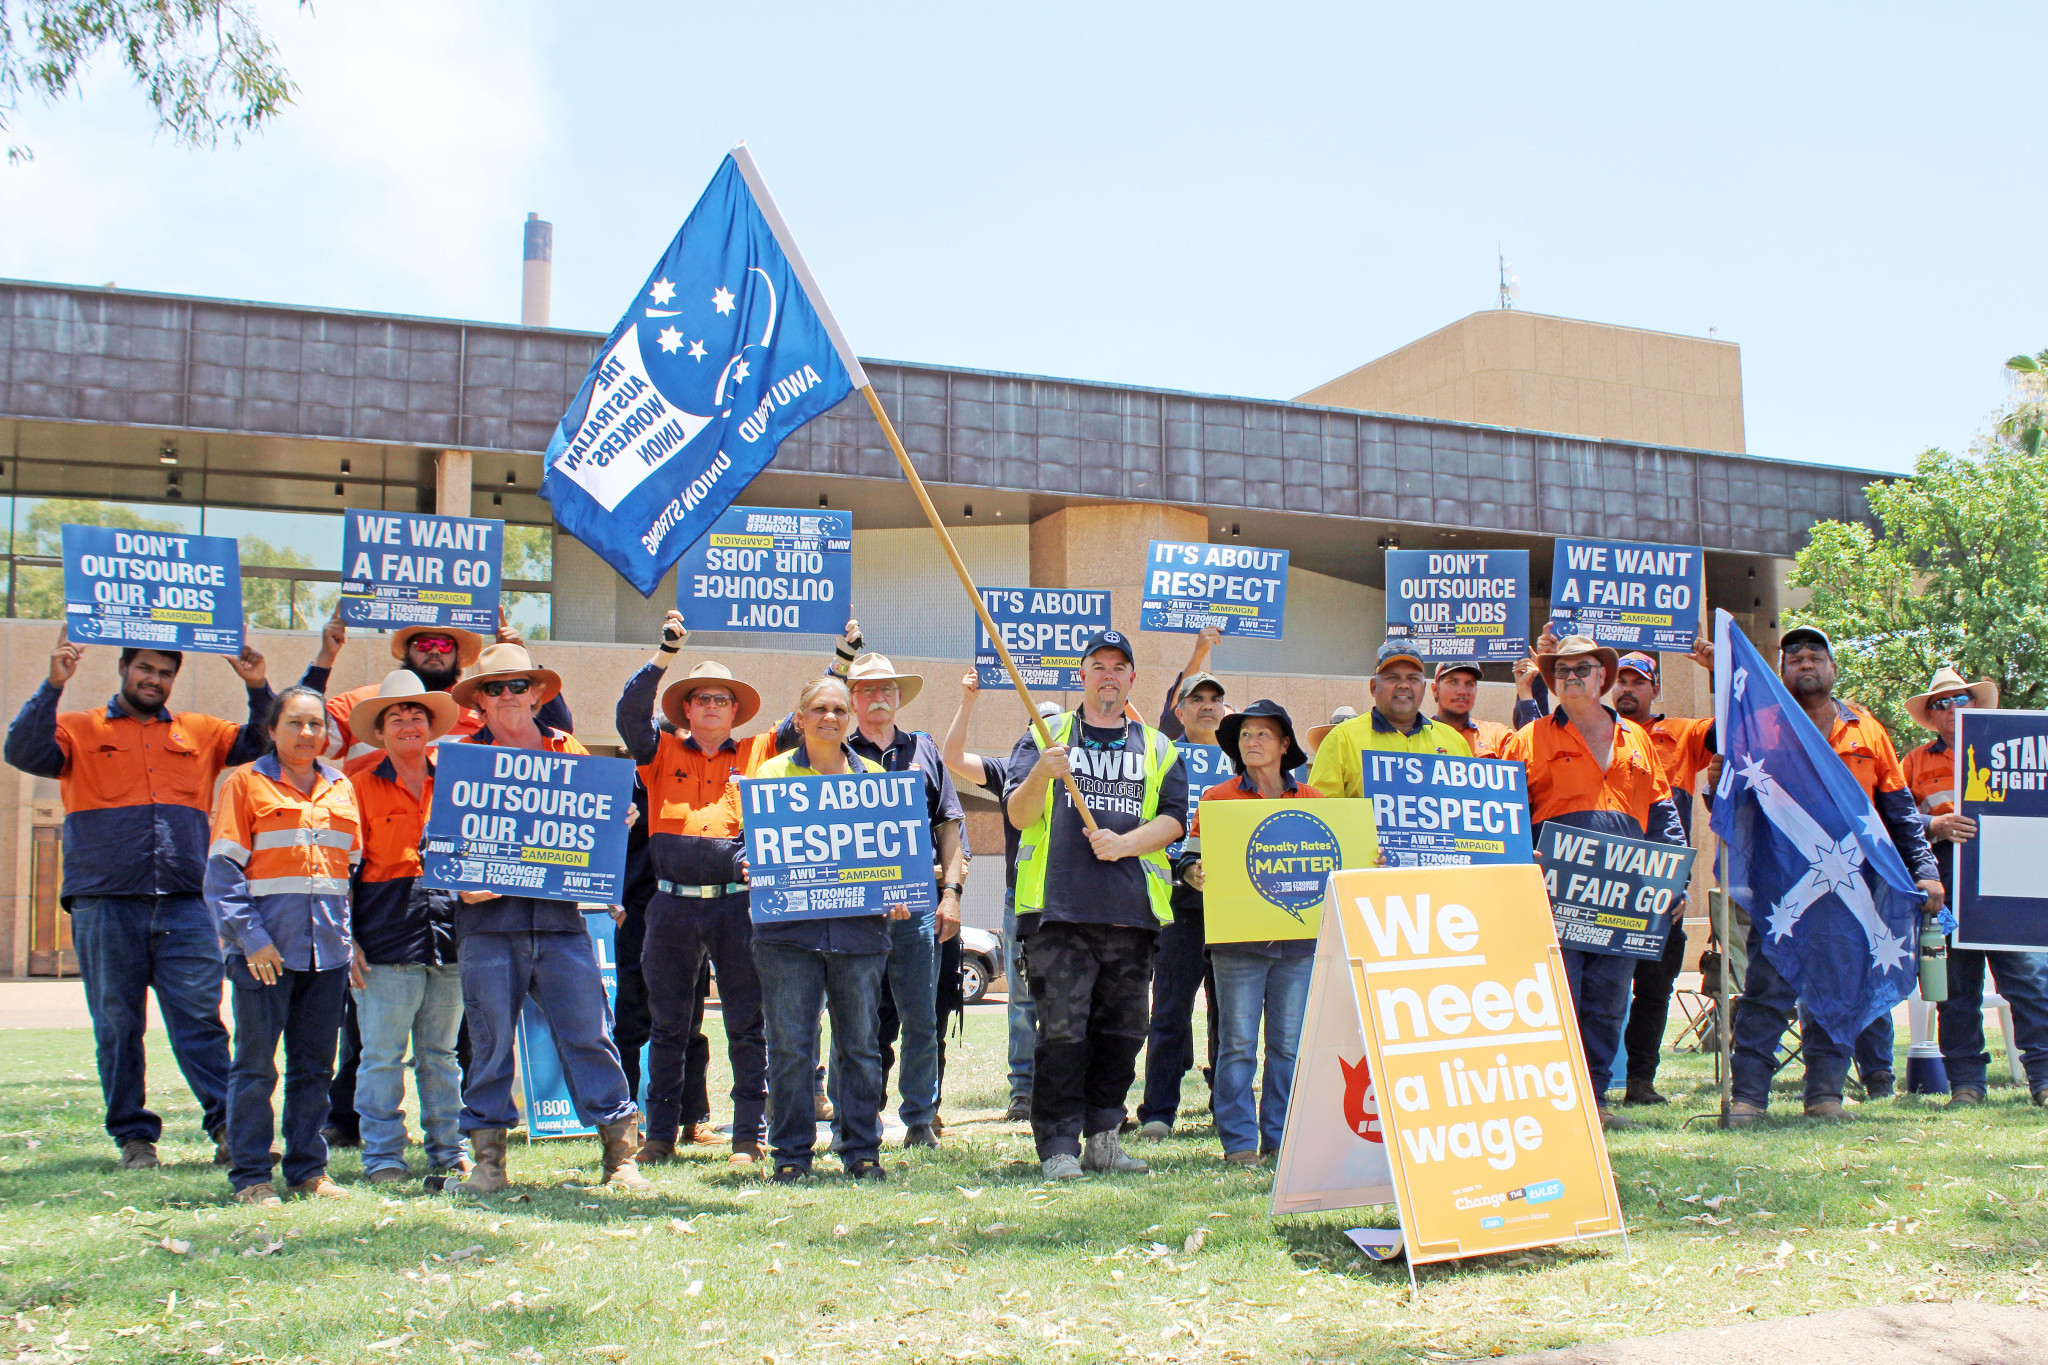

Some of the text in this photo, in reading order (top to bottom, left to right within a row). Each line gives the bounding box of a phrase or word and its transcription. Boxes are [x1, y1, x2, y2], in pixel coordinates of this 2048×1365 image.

[748, 514, 798, 524] TOGETHER
[357, 515, 493, 551] WE WANT
[746, 522, 798, 534] STRONGER
[115, 532, 189, 558] DON'T
[716, 536, 770, 546] CAMPAIGN
[794, 540, 818, 550] AWU
[828, 540, 850, 550] AWU
[706, 548, 823, 574] OUR JOBS
[1155, 543, 1283, 572] IT'S ABOUT
[1428, 554, 1489, 574] DON'T
[1567, 545, 1692, 576] WE WANT
[80, 554, 226, 586] OUTSOURCE
[351, 552, 491, 588] A FAIR GO
[342, 582, 364, 592] AWU
[694, 574, 834, 602] OUTSOURCE
[1150, 570, 1281, 603] RESPECT
[1400, 578, 1516, 599] OUTSOURCE
[1560, 578, 1691, 610] A FAIR GO
[94, 581, 215, 611] OUR JOBS
[376, 588, 400, 597] AWU
[418, 592, 466, 603] CAMPAIGN
[982, 590, 1105, 616] IT'S ABOUT
[104, 605, 131, 615] AWU
[151, 610, 206, 622] CAMPAIGN
[390, 604, 440, 614] STRONGER
[1142, 602, 1162, 610] AWU
[1172, 602, 1192, 610] AWU
[1209, 604, 1254, 614] CAMPAIGN
[1410, 602, 1507, 623] OUR JOBS
[1552, 609, 1572, 618] AWU
[390, 612, 438, 623] TOGETHER
[451, 612, 473, 622] AWU
[727, 604, 799, 628] DON'T
[1184, 614, 1229, 624] STRONGER
[1582, 610, 1667, 624] AWU CAMPAIGN
[122, 622, 178, 634] STRONGER
[1388, 626, 1408, 636] AWU
[1418, 624, 1499, 634] AWU CAMPAIGN
[1595, 624, 1641, 634] STRONGER
[124, 631, 177, 642] TOGETHER
[1432, 638, 1476, 647] STRONGER
[1595, 632, 1640, 642] TOGETHER
[1432, 646, 1474, 656] TOGETHER
[976, 656, 994, 664] AWU
[1021, 677, 1058, 685] OGETHER
[494, 752, 578, 784] DON'T
[1068, 746, 1145, 780] AWU
[1372, 756, 1520, 792] IT'S ABOUT
[1992, 770, 2048, 790] FIGHT
[751, 777, 916, 814] IT'S ABOUT
[1065, 776, 1144, 800] TRONGER
[452, 780, 613, 820] OUTSOURCE
[1065, 792, 1142, 818] TGETHER
[1373, 794, 1524, 835] RESPECT
[461, 814, 596, 850] OUR JOBS
[428, 840, 456, 854] AWU
[754, 820, 922, 865] RESPECT
[1256, 840, 1332, 854] Penalty Rates
[1410, 834, 1435, 844] AWU
[1455, 840, 1498, 851] AMPAIGN
[469, 842, 499, 854] AWU
[520, 850, 582, 864] CAMPAIGN
[1420, 853, 1472, 864] STRONGER
[1553, 832, 1686, 880] WE WANT
[486, 862, 548, 878] STRONGER
[1255, 856, 1334, 875] MATTER
[486, 874, 545, 889] TOGETHER
[563, 876, 591, 888] AWU
[750, 875, 776, 888] AWU
[790, 868, 896, 881] AWU CAMPAIGN
[810, 886, 866, 900] STRONGER
[884, 890, 908, 900] AWU
[1546, 868, 1672, 915] A FAIR GO
[810, 896, 865, 910] TOGETHER
[1555, 906, 1642, 928] AWU CAMPAIGN
[1355, 894, 1480, 958] We
[1566, 923, 1614, 938] STRONGER
[1565, 932, 1610, 946] TOGETHER
[1376, 962, 1561, 1040] need
[1394, 1053, 1578, 1112] a living
[534, 1100, 570, 1116] 1800
[536, 1118, 584, 1130] www.kee
[1402, 1114, 1543, 1170] wage
[1455, 1192, 1506, 1210] Change
[1529, 1184, 1559, 1199] RULES
[1484, 1219, 1499, 1228] Join
